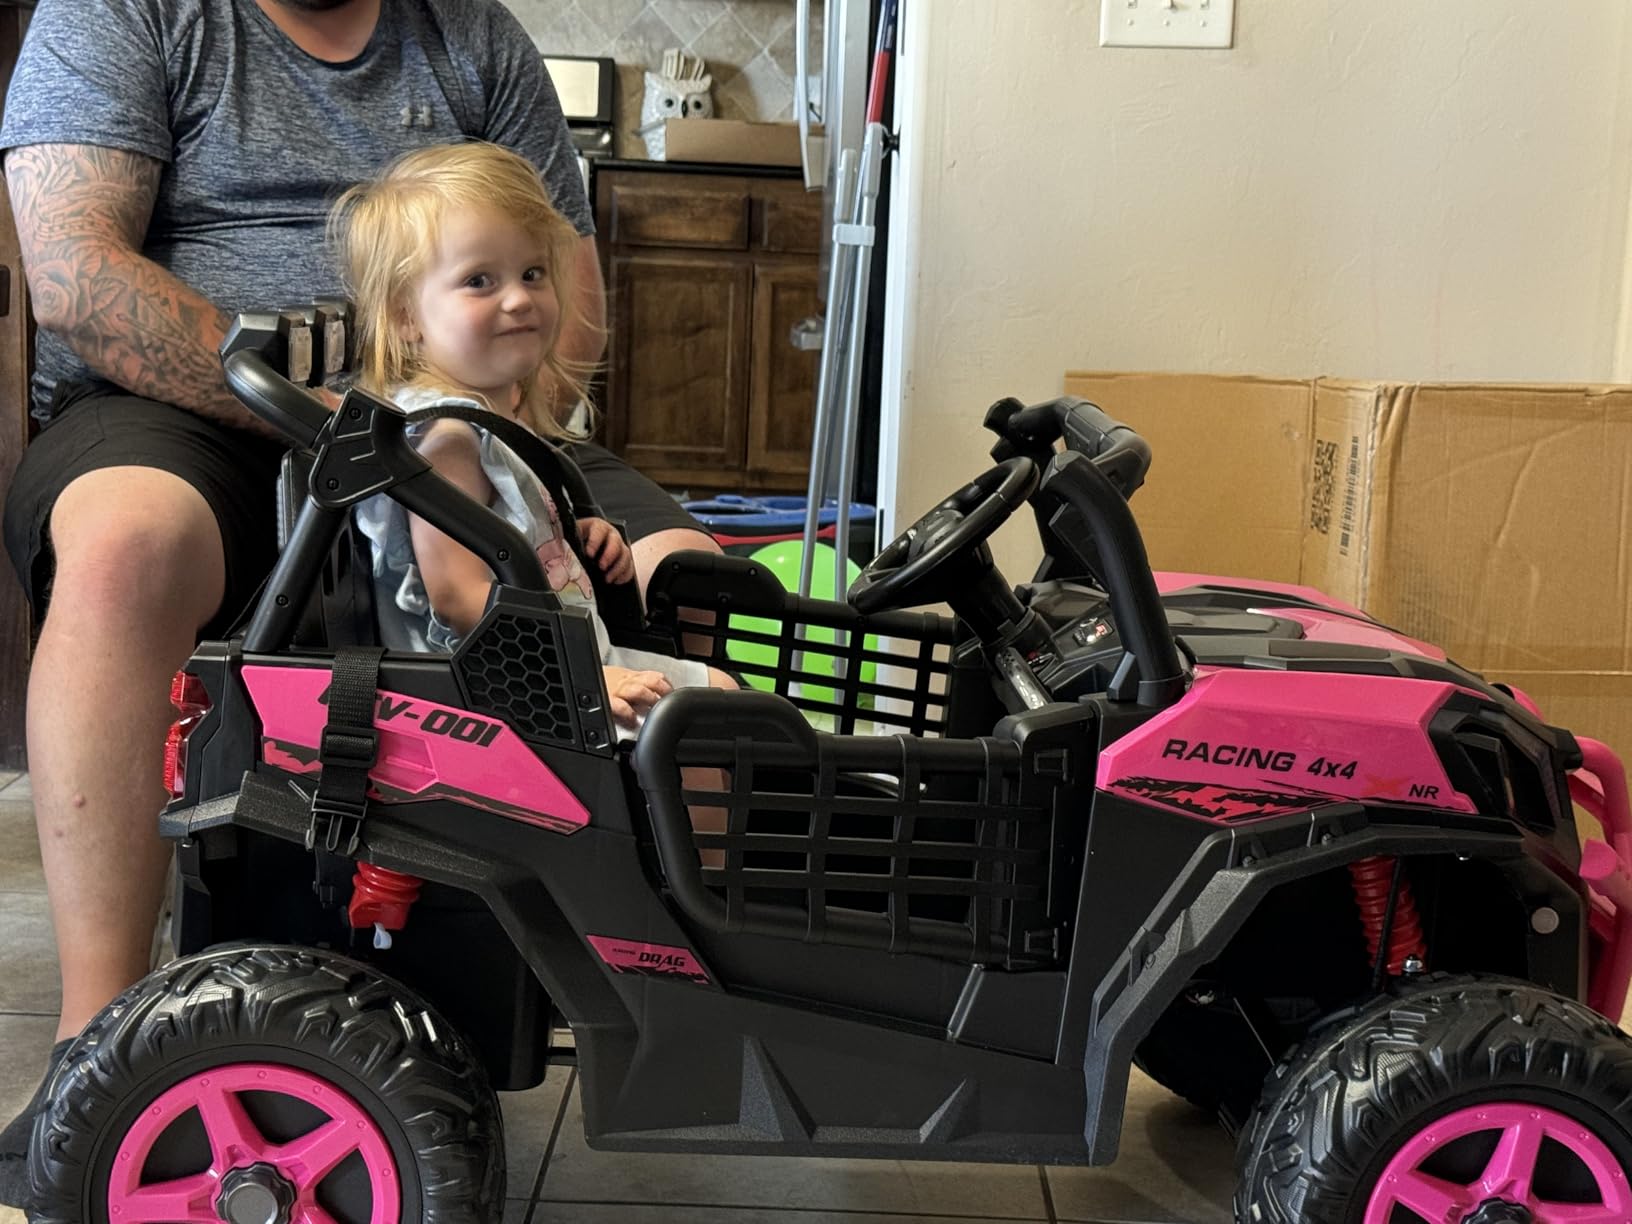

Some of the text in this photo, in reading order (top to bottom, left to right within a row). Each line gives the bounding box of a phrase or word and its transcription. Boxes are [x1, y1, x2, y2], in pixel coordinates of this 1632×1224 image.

[1162, 739, 1358, 780] RACING 4x4
[1408, 783, 1440, 800] NR
[638, 952, 686, 967] DRAG
